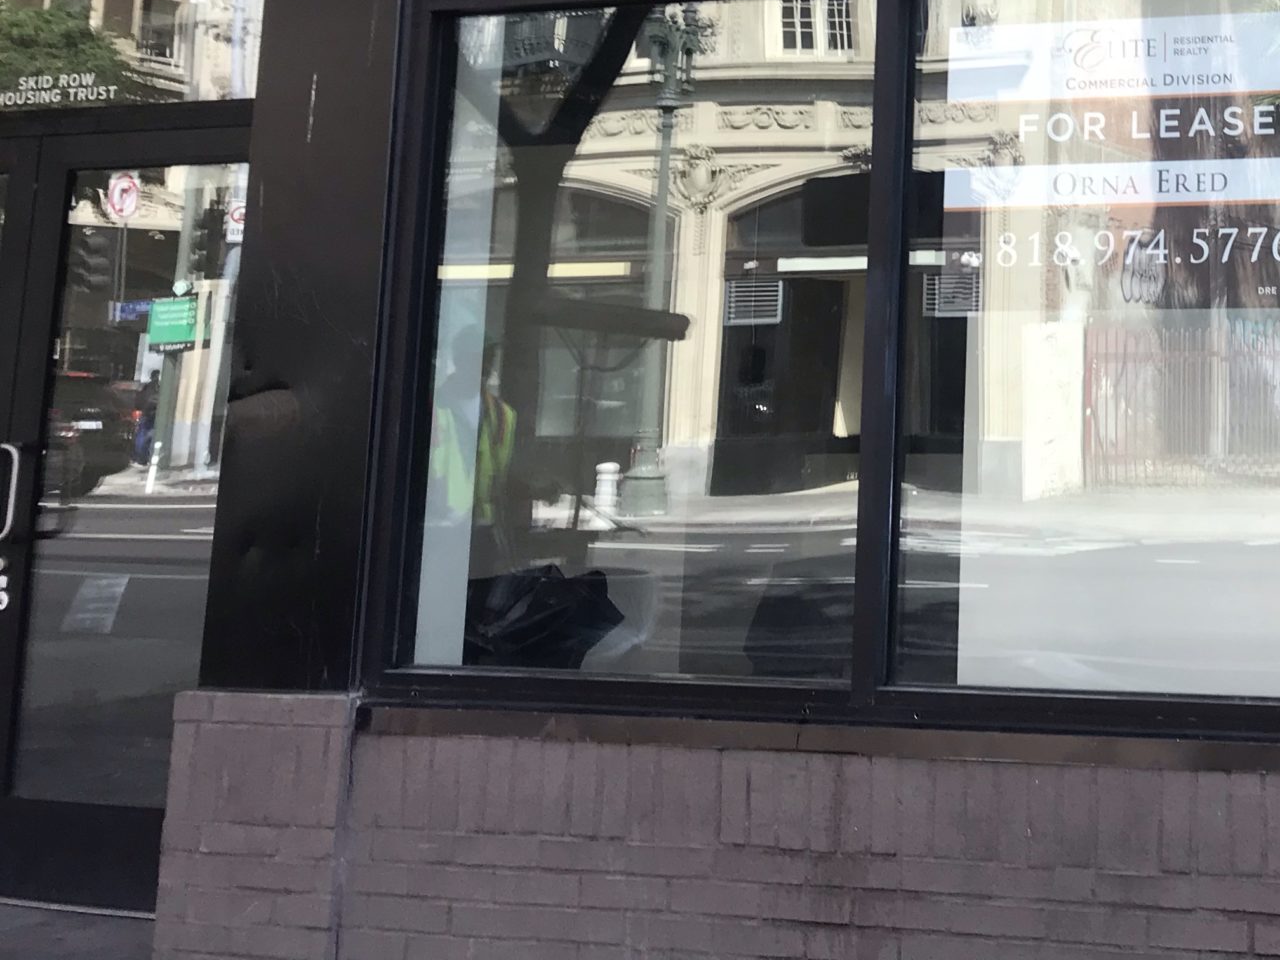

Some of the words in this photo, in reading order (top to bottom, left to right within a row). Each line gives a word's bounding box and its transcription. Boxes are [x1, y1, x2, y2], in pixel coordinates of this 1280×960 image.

[1173, 34, 1234, 46] RESIDENTIAL
[1173, 46, 1210, 57] REALTY
[18, 75, 54, 90] SKID
[58, 72, 96, 87] ROW
[1065, 77, 1158, 91] COMMERCIAL
[1163, 73, 1233, 88] DIVISION
[67, 85, 118, 101] TRUST
[1018, 111, 1106, 143] FOR
[1131, 105, 1276, 140] LEASE
[1053, 171, 1140, 196] ORNA
[1156, 169, 1229, 194] ERED
[1257, 286, 1277, 295] DRE
